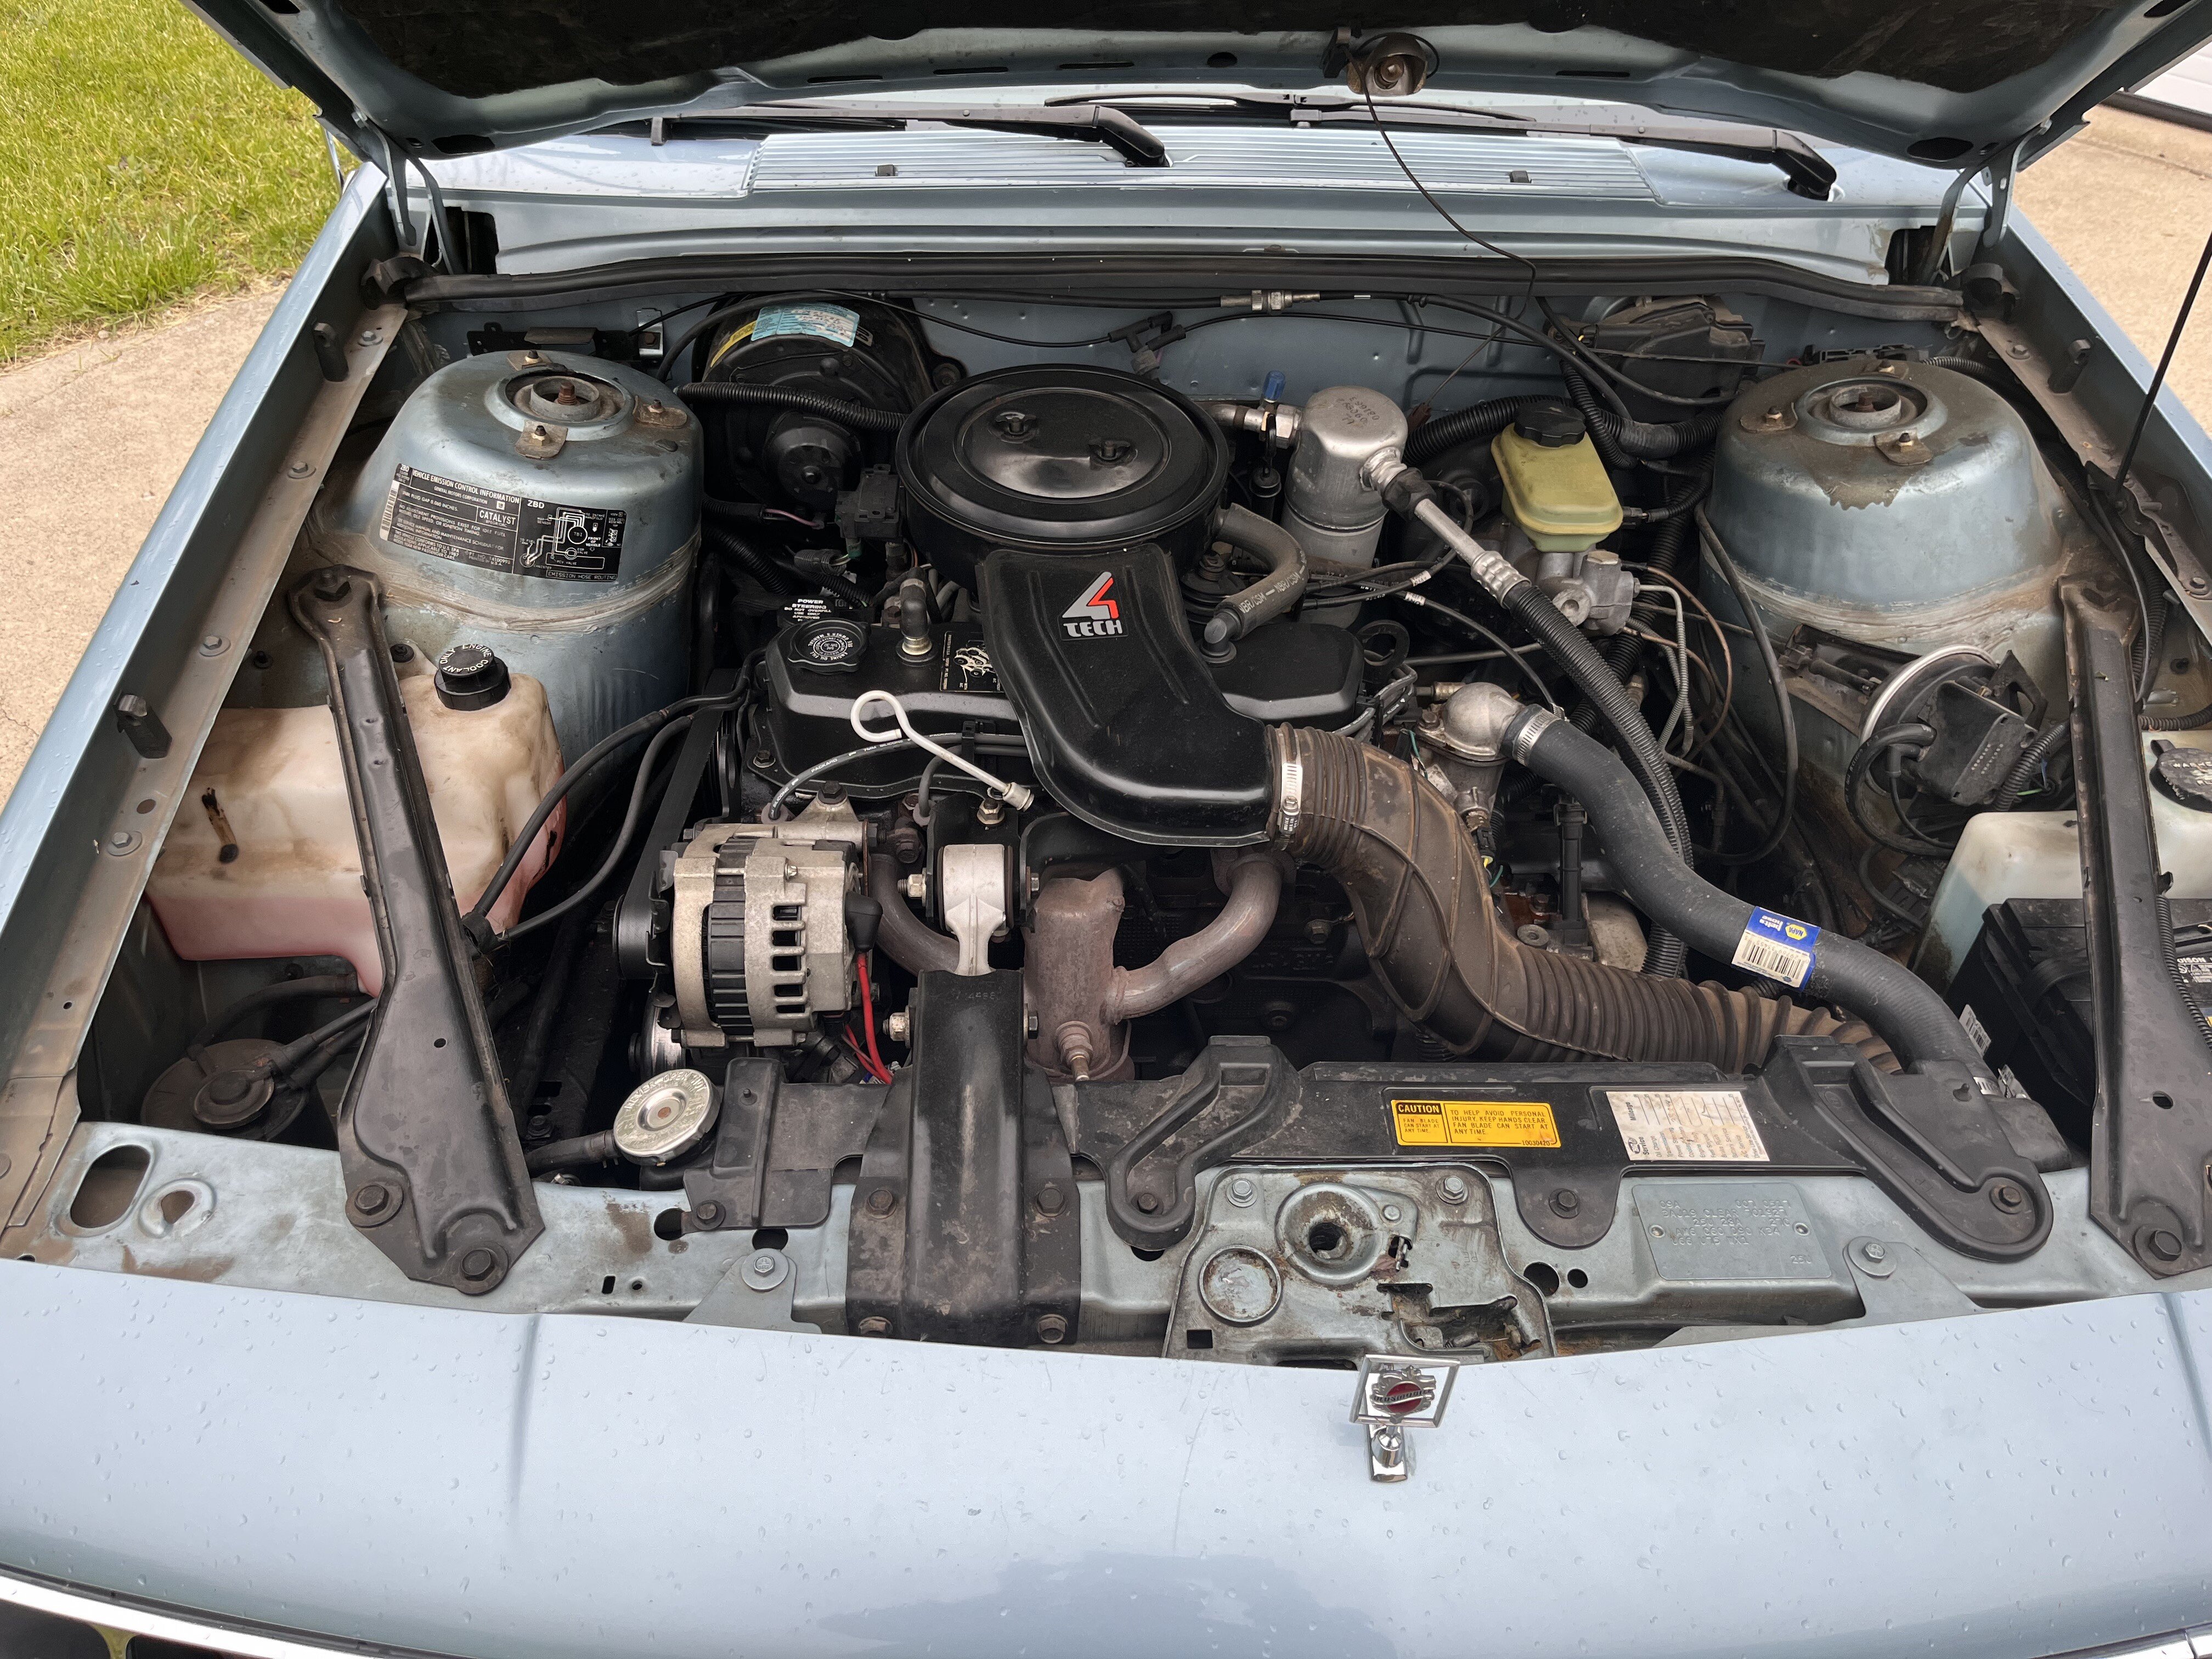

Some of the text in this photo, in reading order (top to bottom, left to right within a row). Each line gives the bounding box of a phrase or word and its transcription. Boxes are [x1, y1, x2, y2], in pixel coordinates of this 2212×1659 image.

[413, 469, 430, 480] VEHICLE
[431, 476, 454, 487] EMISSION
[455, 482, 478, 494] CONTROL
[480, 489, 520, 504] INFORMATION
[448, 489, 462, 498] MOTORS
[462, 494, 488, 504] CORPORATION
[527, 500, 544, 509] ZBD
[431, 514, 455, 524] PROVISIONS
[479, 510, 516, 525] CATALYST
[443, 523, 462, 532] IGNITION
[416, 537, 436, 547] CONFORMS
[417, 540, 441, 551] APPLICABLE
[441, 532, 471, 543] MAINTENANCE
[472, 540, 495, 548] SCHEDULE
[421, 548, 444, 558] PASSENGER
[1062, 571, 1120, 620] 4
[1063, 619, 1123, 637] TECH
[808, 634, 824, 646] MANUAL
[440, 648, 455, 664] ONLY
[462, 644, 492, 658] ENGINE
[830, 652, 848, 661] ENGINE
[443, 659, 489, 673] COOLANT
[772, 787, 790, 808] SILICONE
[811, 758, 838, 773] PACKARD
[1788, 927, 1804, 936] NAPA
[624, 1081, 656, 1109] NEVER
[663, 1071, 691, 1082] OPEN
[1398, 1104, 1440, 1113] CAUTION
[1624, 1102, 1636, 1121] Mileage
[1668, 1127, 1678, 1143] Steering
[1742, 1125, 1751, 1138] Service
[1638, 1137, 1649, 1155] Service
[1650, 1136, 1659, 1150] Change
[1659, 1131, 1673, 1157] Transmission
[1703, 1134, 1712, 1148] Service
[1722, 1127, 1738, 1158] Battery Service
[1736, 1135, 1745, 1149] Service
[1684, 1142, 1695, 1157] Cooling
[1696, 1144, 1706, 1158] Engine
[1719, 1147, 1727, 1158] Brake
